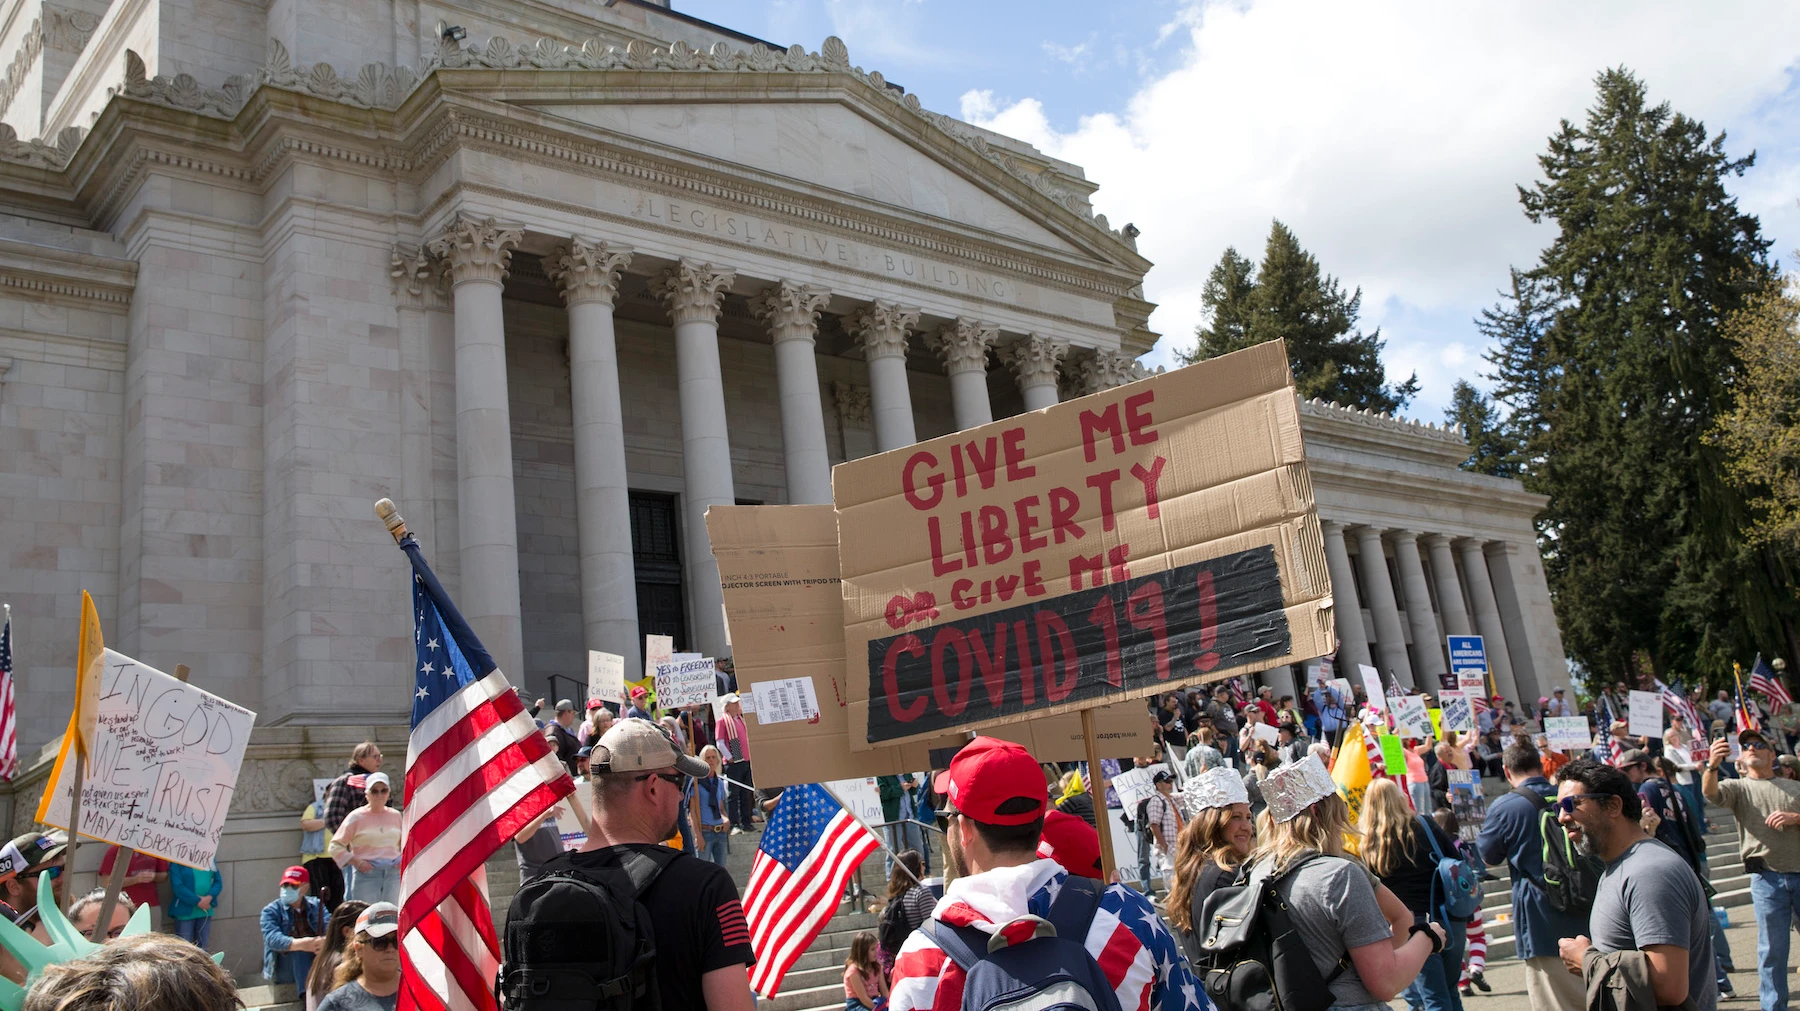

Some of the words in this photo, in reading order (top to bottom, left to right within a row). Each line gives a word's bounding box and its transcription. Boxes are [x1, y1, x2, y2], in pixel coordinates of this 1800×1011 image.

[648, 198, 848, 262] LEGISLATIVE
[884, 253, 1005, 298] BUILDING
[902, 426, 1036, 511] GIVE
[1078, 389, 1159, 463] ME
[927, 455, 1167, 578] LIBERTY
[755, 572, 789, 580] PORTABLE
[884, 590, 940, 630] OR
[950, 559, 1047, 611] GIVE
[1068, 543, 1132, 591] ME
[656, 664, 671, 676] YES
[680, 660, 714, 673] FREEDOM
[882, 609, 1080, 723] COVID
[1461, 641, 1472, 649] ALL
[99, 663, 152, 714] IN
[144, 688, 233, 756] GOD
[657, 675, 671, 686] NO
[657, 687, 671, 697] NO
[659, 697, 674, 708] NO
[674, 696, 684, 704] TO
[93, 731, 136, 787] WE
[1117, 774, 1141, 793] ALL
[143, 760, 236, 833] TRUST
[83, 810, 116, 839] MAY
[137, 828, 174, 857] BACK
[175, 842, 188, 859] TO
[189, 844, 214, 870] WORK
